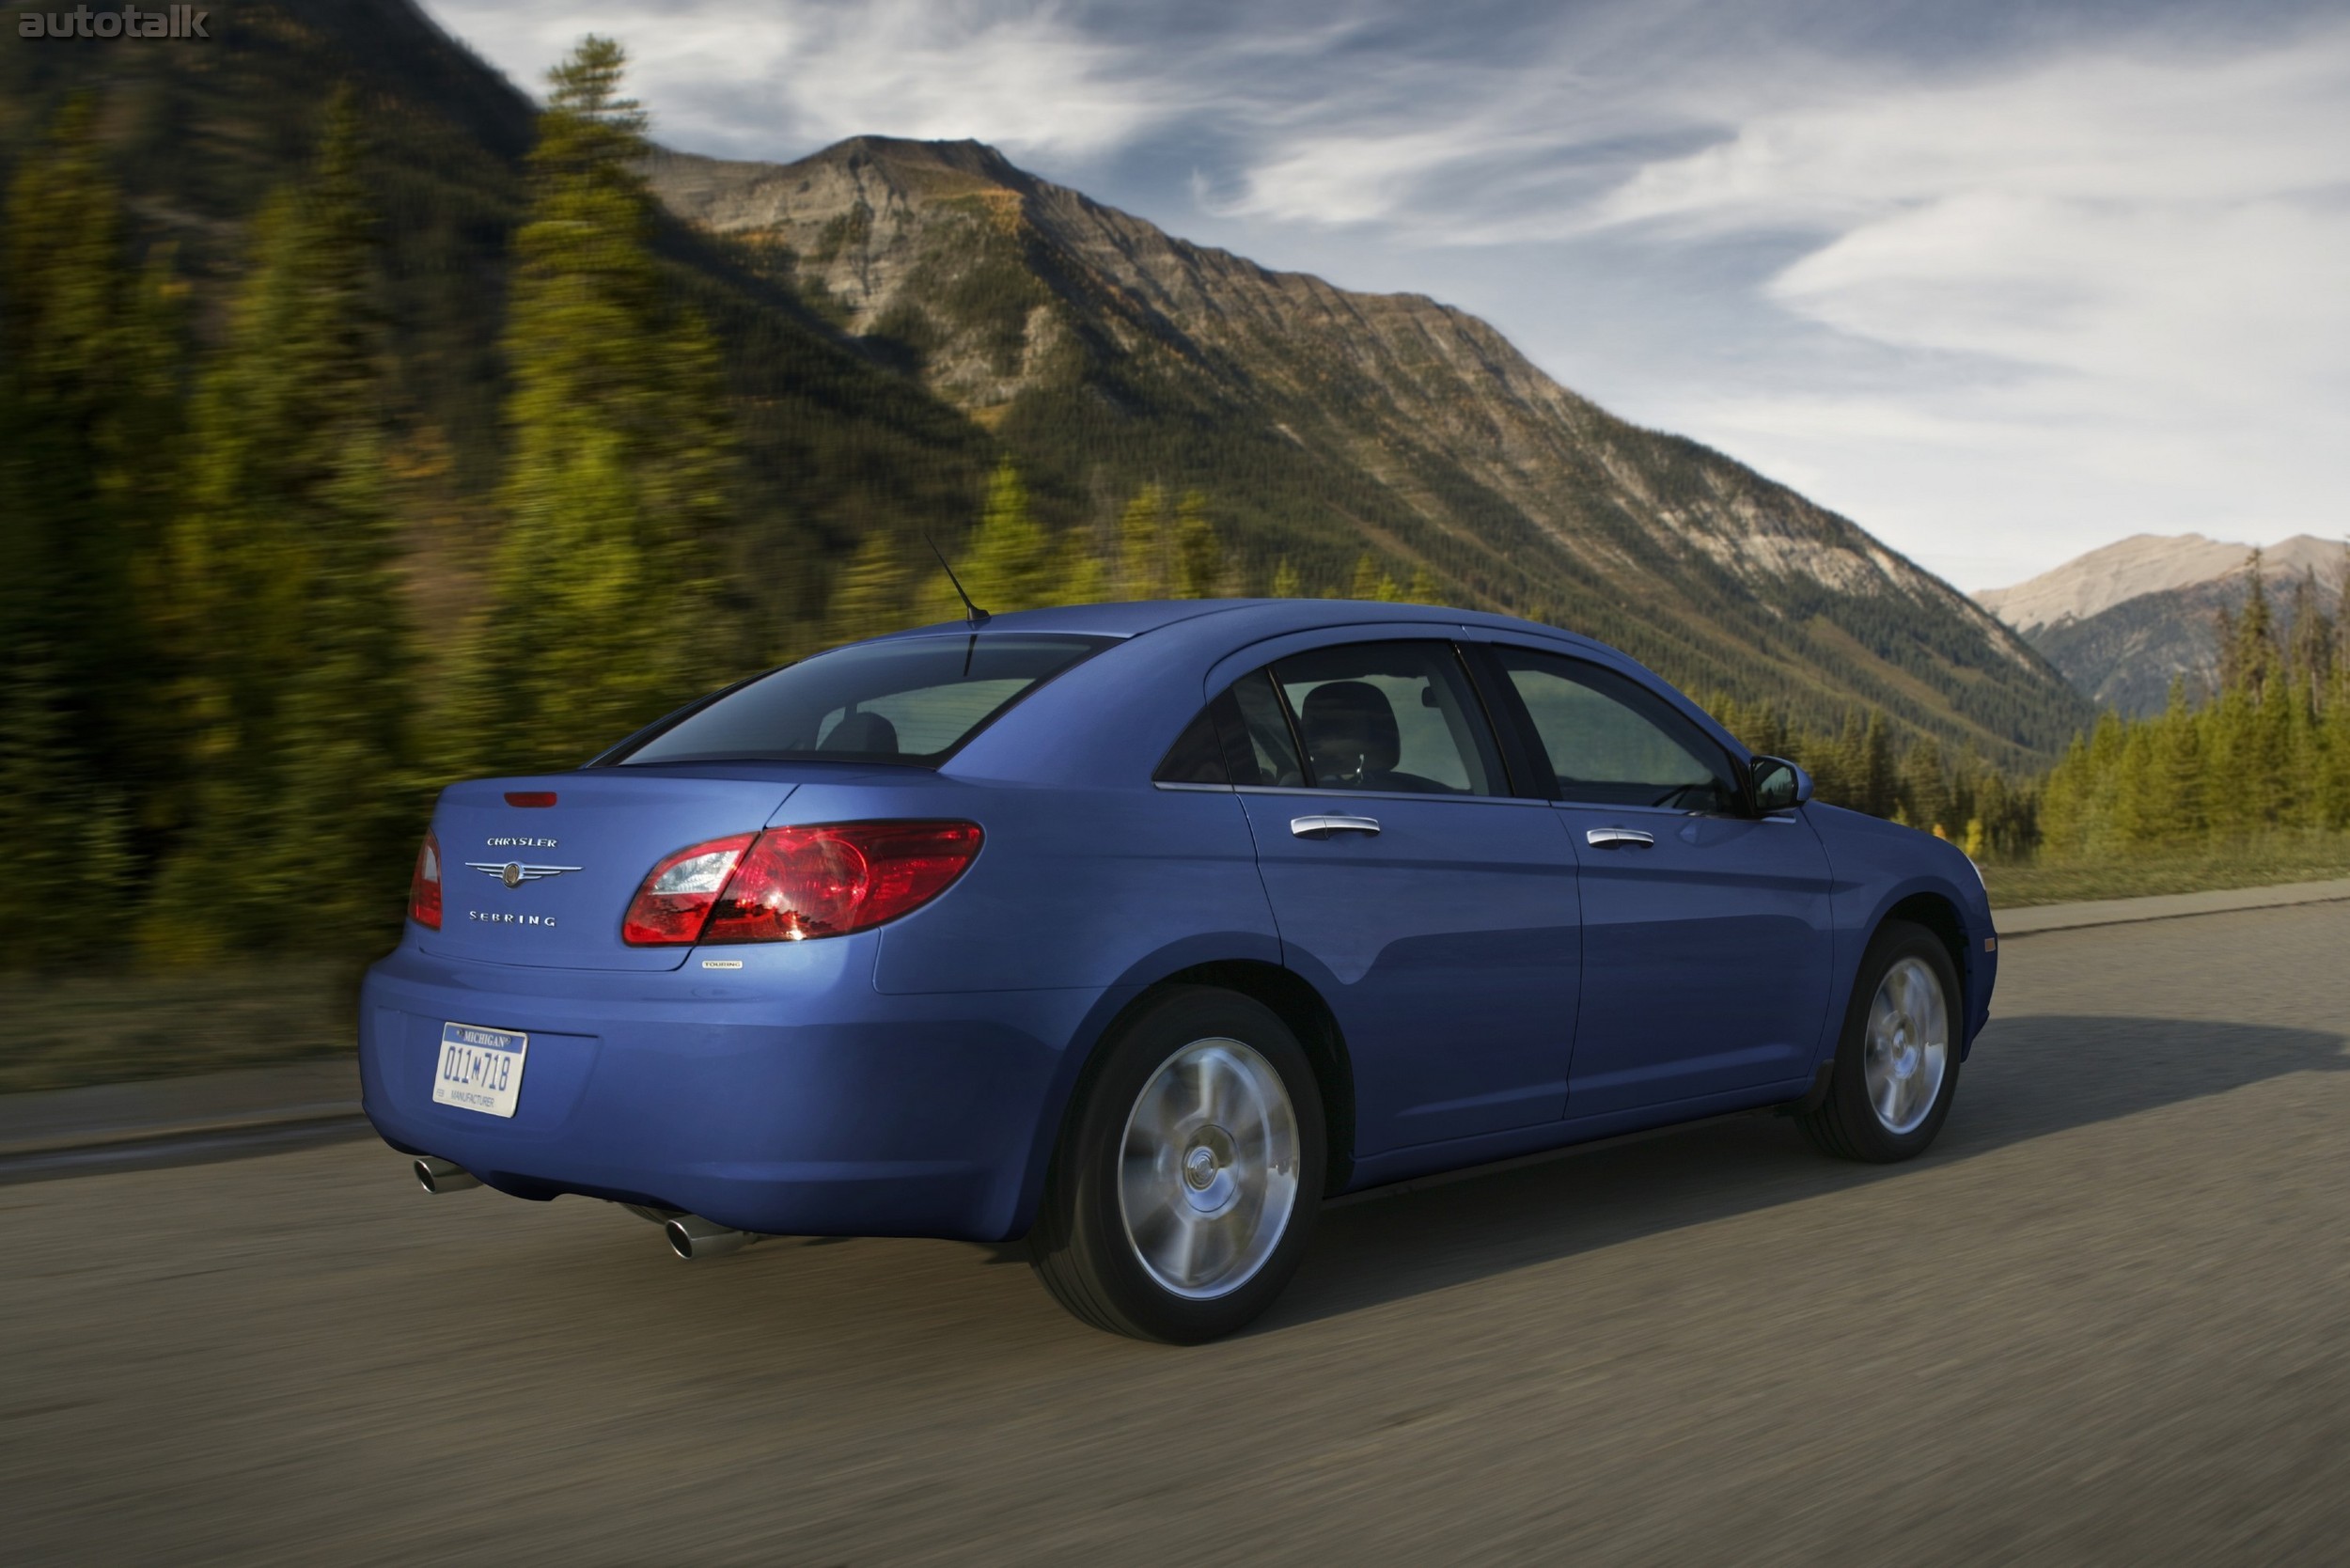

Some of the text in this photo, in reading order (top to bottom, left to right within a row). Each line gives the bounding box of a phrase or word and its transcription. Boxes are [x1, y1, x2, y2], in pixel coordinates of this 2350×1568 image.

[487, 838, 557, 847] CHRYSLER
[469, 911, 556, 927] SEBRING
[463, 1030, 505, 1048] MICHIGAN
[451, 1090, 494, 1107] MANUFACTURER
